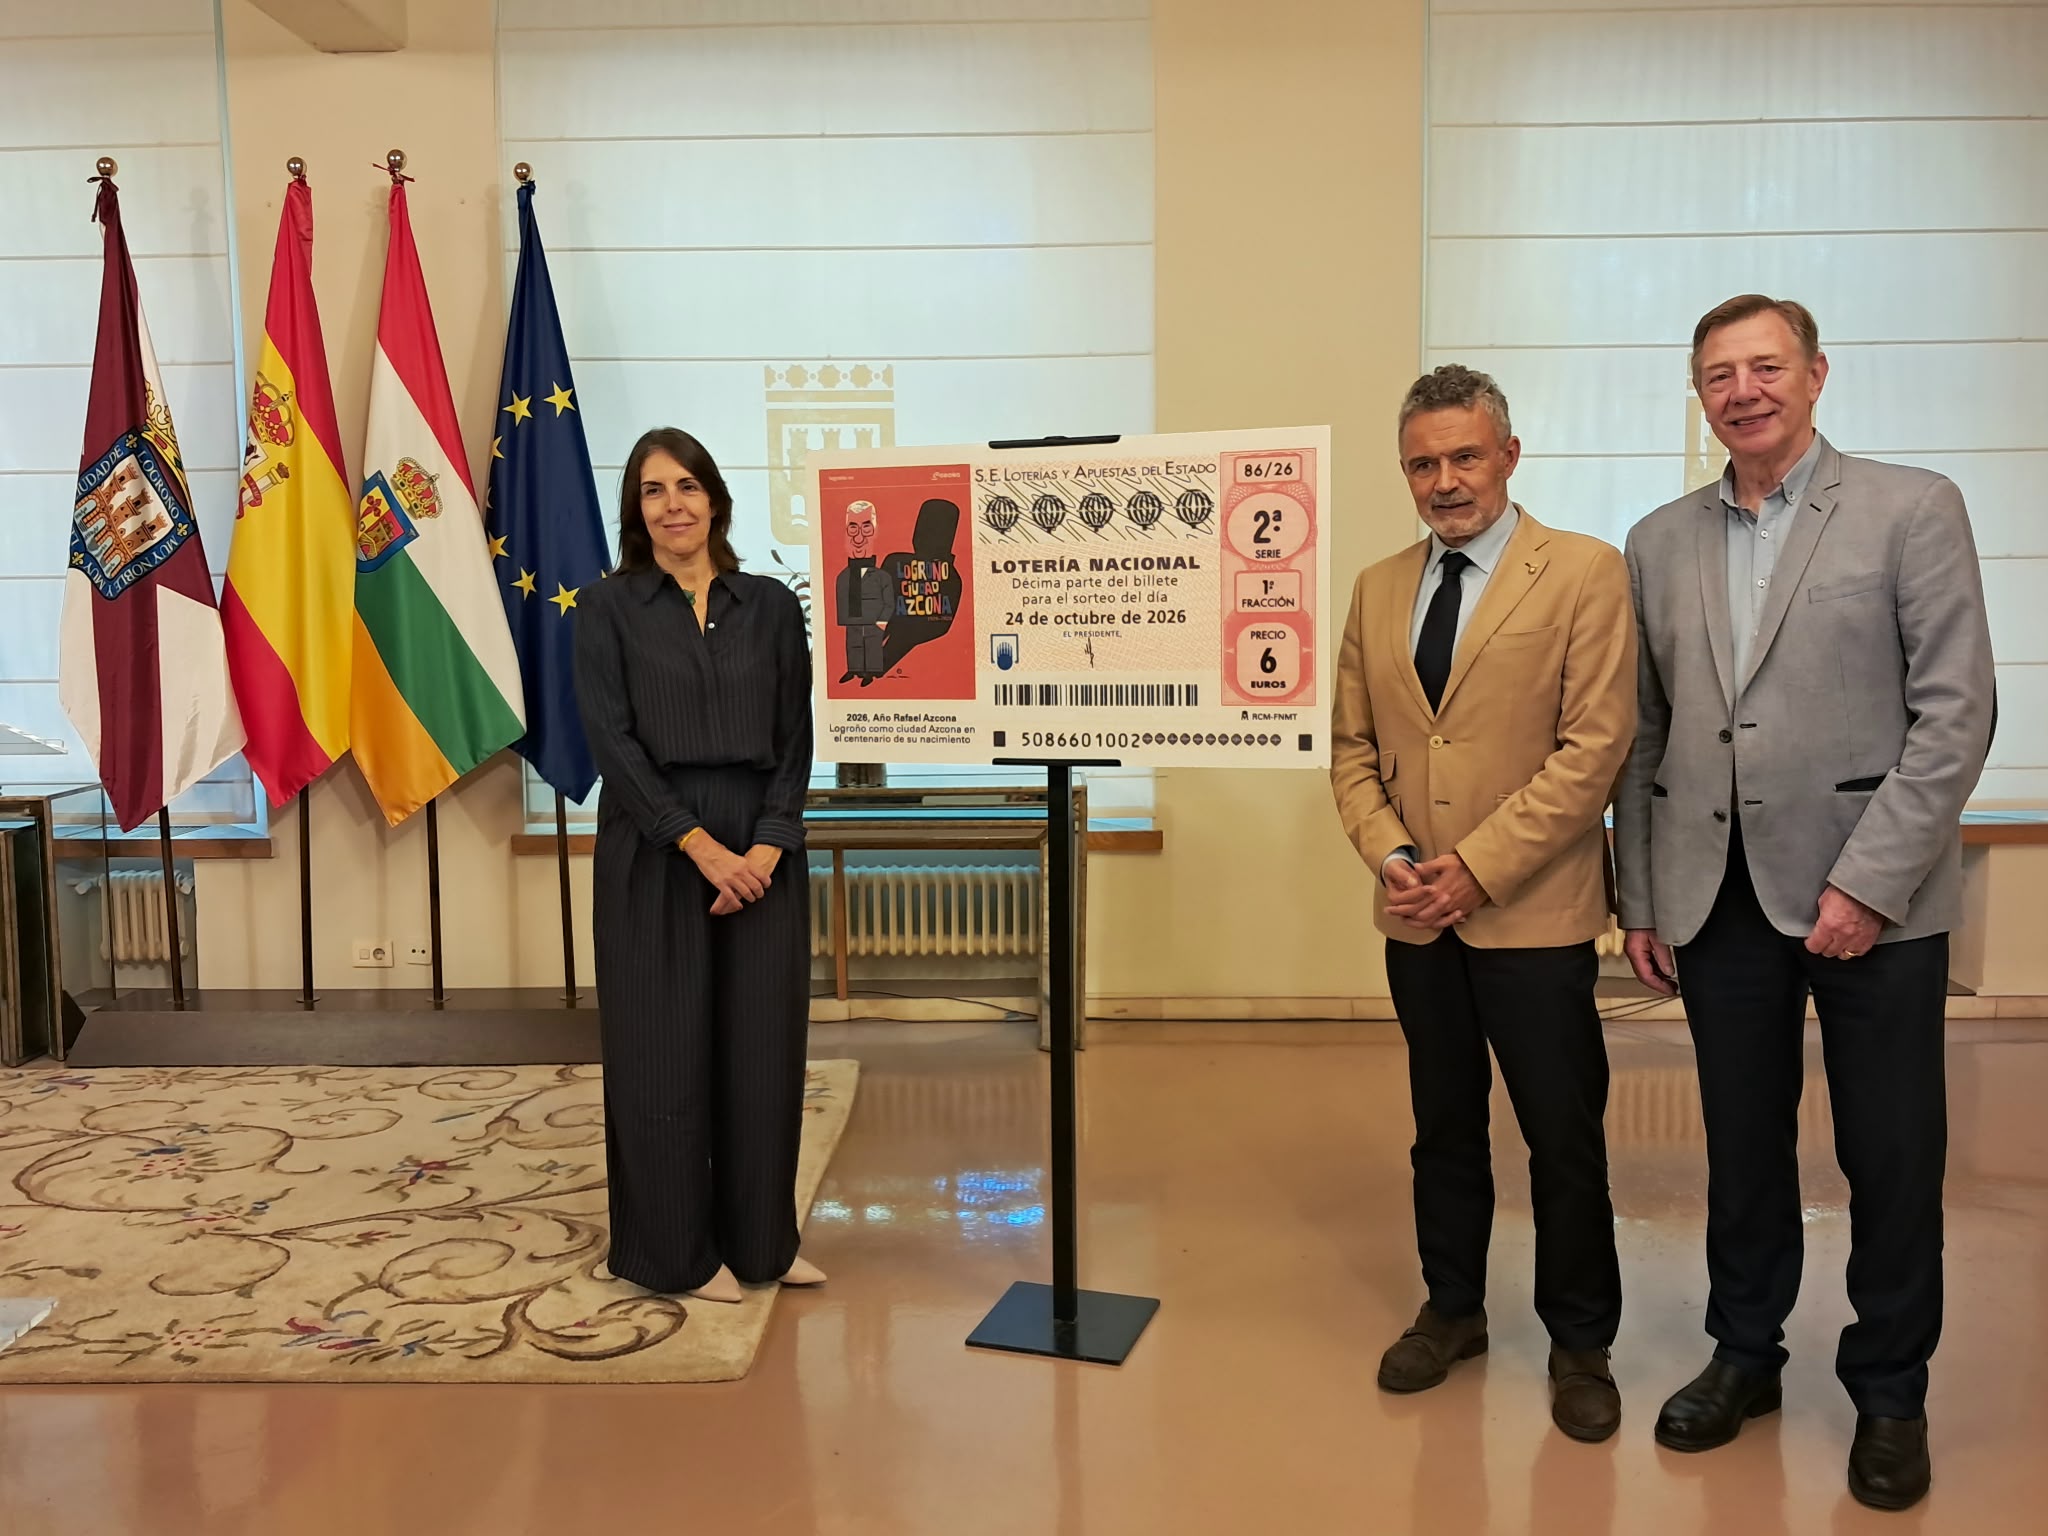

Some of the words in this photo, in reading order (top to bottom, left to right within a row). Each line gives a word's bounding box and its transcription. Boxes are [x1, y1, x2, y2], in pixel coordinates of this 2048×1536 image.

[76, 460, 110, 496] IUDAD
[109, 444, 125, 466] DE
[1004, 467, 1058, 482] LOTERÍAS
[1062, 469, 1070, 479] Y
[1074, 465, 1137, 479] APUESTAS
[1141, 466, 1162, 476] DEL
[1165, 461, 1217, 475] ESTADO
[1244, 462, 1293, 478] 86/26
[138, 450, 180, 519] LOGROÑO
[153, 536, 179, 563] MUY
[1255, 549, 1282, 559] SERIE
[896, 559, 949, 581] LOGROÑO
[991, 556, 1081, 574] LOTERÍA
[1089, 555, 1201, 572] NACIONAL
[83, 561, 106, 591] MUY
[113, 558, 153, 592] NOBLE
[1012, 576, 1061, 589] Décima
[1066, 577, 1102, 591] parte
[1107, 575, 1128, 588] del
[1133, 574, 1178, 587] billete
[896, 594, 952, 616] AZCONA
[1022, 595, 1051, 608] para
[1056, 591, 1068, 604] el
[1073, 592, 1116, 604] sorteo
[1120, 590, 1142, 603] del
[1146, 589, 1168, 603] día
[1241, 596, 1295, 608] FRACCIÓN
[1005, 612, 1024, 626] 24
[1028, 610, 1049, 626] de
[1053, 610, 1116, 626] octubre
[1121, 609, 1142, 625] de
[1147, 610, 1187, 624] 2026
[1250, 630, 1287, 640] PRECIO
[1260, 647, 1277, 674] 6
[1250, 680, 1287, 689] EUROS
[846, 713, 871, 723] 2026,
[872, 713, 892, 722] Año
[893, 713, 921, 722] Rafael
[922, 713, 957, 723] Azcona
[1252, 713, 1298, 721] RCM-FNMT
[829, 724, 867, 735] Logroño
[868, 726, 894, 734] como
[896, 725, 927, 734] ciudad
[928, 725, 962, 734] Azcona
[833, 734, 842, 743] el
[843, 735, 891, 743] centenario
[893, 735, 905, 743] de
[919, 735, 971, 744] nacimiento
[1020, 731, 1141, 749] 5086601002
